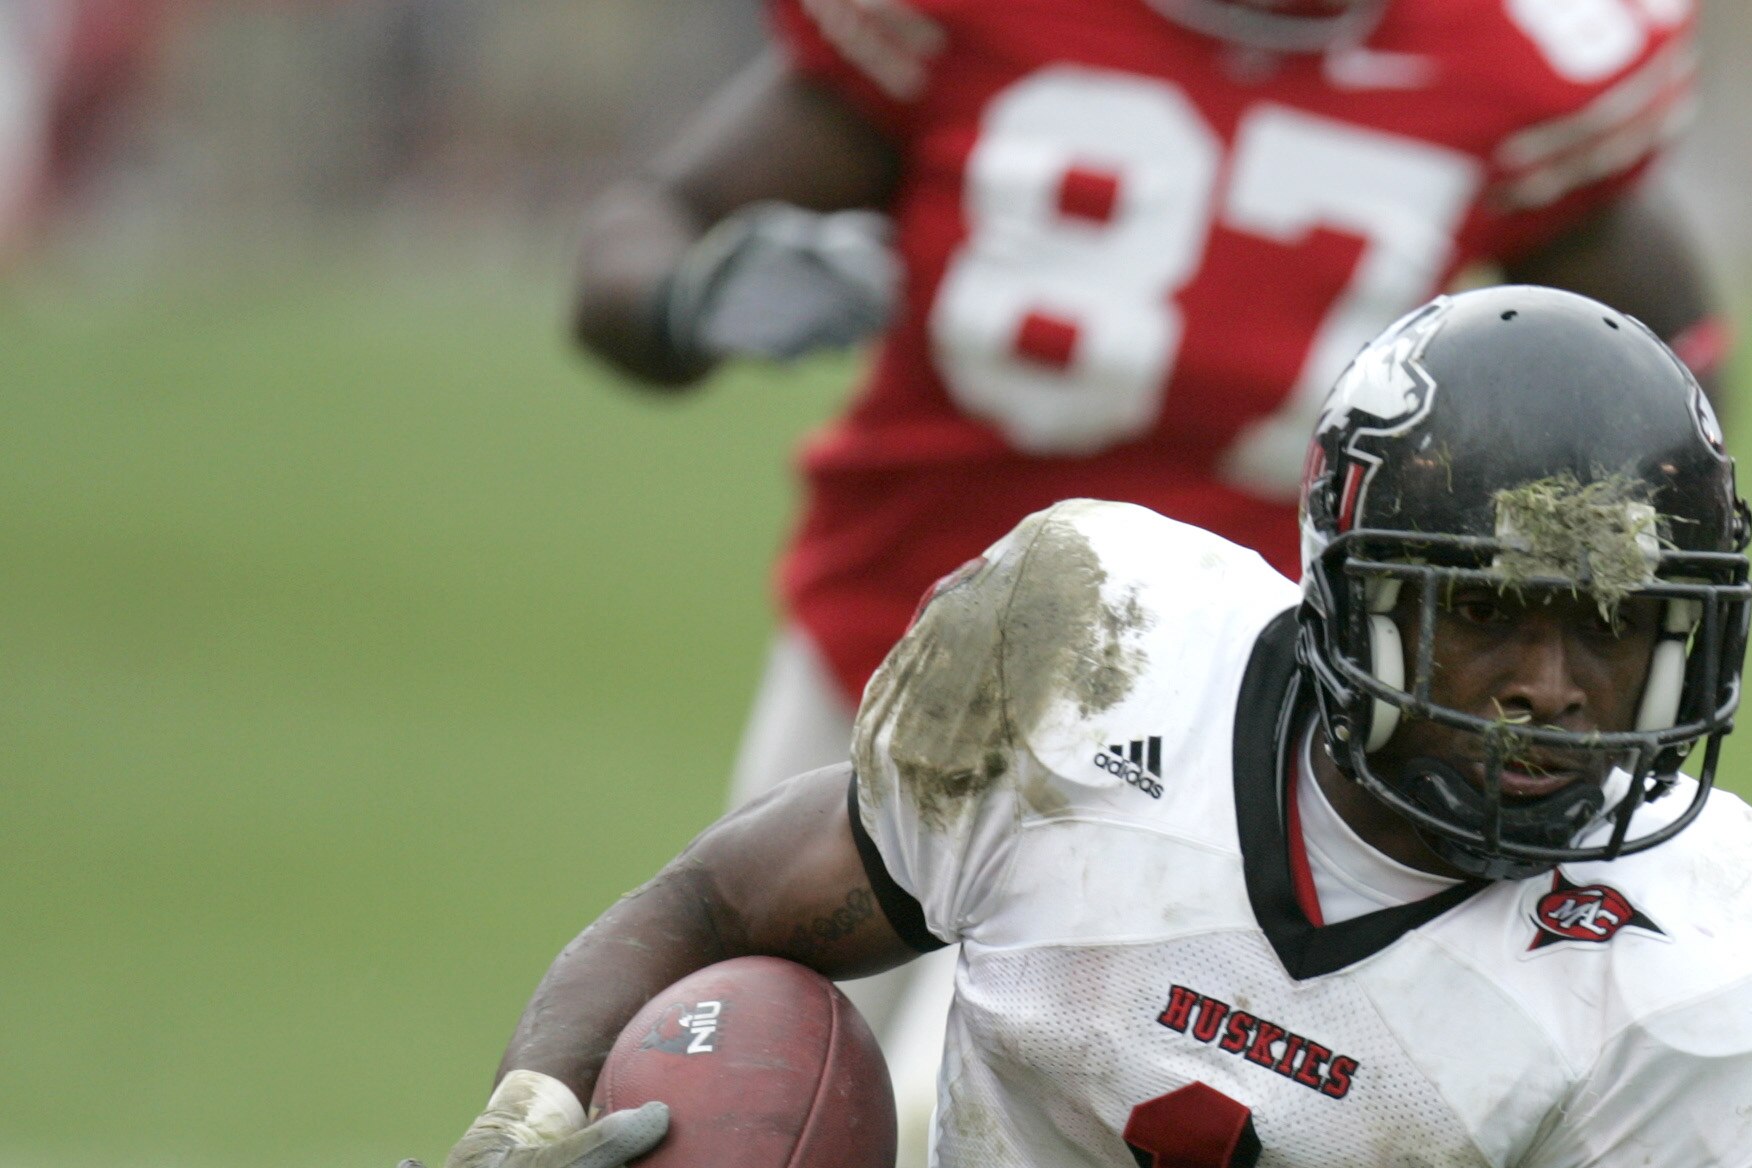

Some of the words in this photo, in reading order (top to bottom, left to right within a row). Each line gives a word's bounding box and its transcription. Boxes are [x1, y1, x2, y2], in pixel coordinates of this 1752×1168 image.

[928, 62, 1484, 503] 87
[1093, 752, 1164, 799] adidas
[686, 1001, 721, 1054] NIU
[1157, 984, 1360, 1100] HUSKIES
